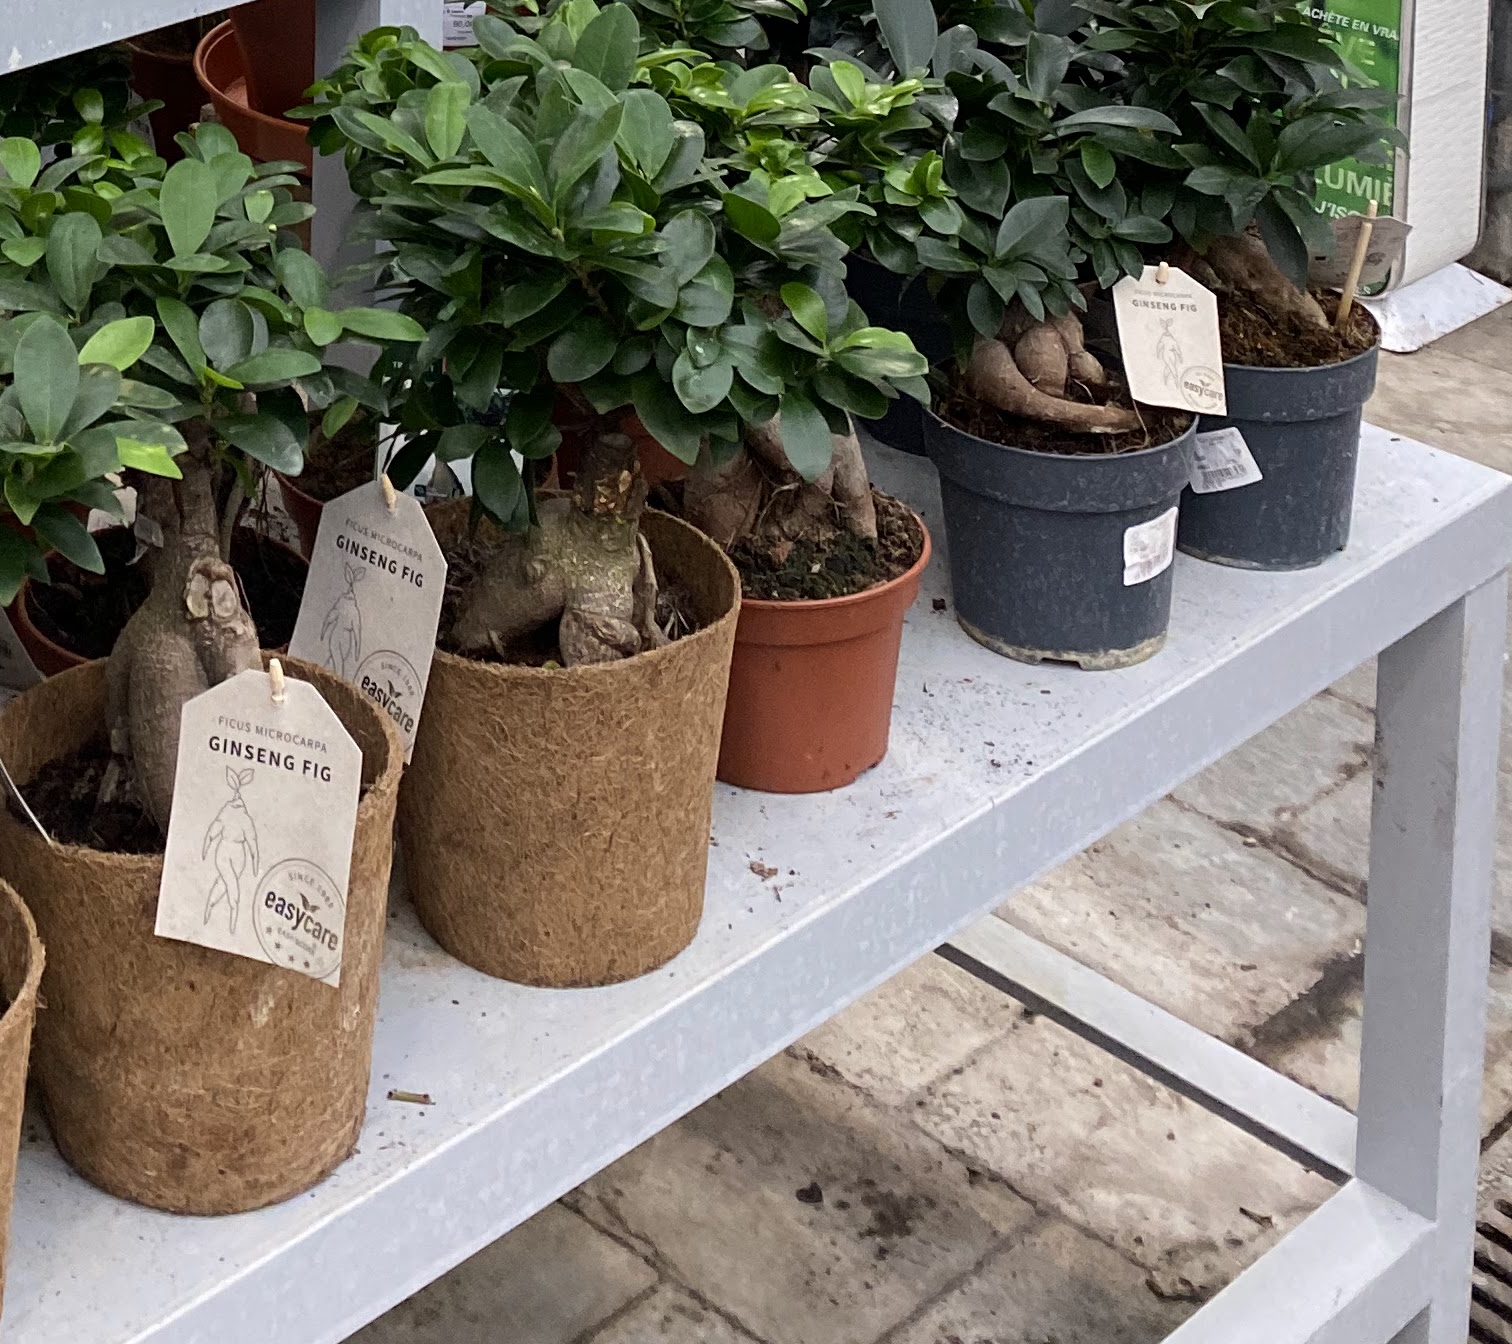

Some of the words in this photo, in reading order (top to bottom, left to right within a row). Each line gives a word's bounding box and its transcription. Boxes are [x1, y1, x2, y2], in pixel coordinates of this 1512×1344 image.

[1303, 6, 1351, 29] ACHÈTE
[1352, 20, 1370, 33] EN
[1373, 24, 1399, 41] VRA
[1132, 298, 1177, 311] GINSENG
[1179, 303, 1197, 313] FIG
[1184, 379, 1224, 402] easycare
[336, 533, 397, 575] GINSENG
[401, 566, 424, 589] FIG
[345, 518, 368, 538] FICUS
[370, 531, 423, 564] MICROCARPA
[218, 714, 252, 735] FICUS
[254, 723, 328, 754] MICROCARPA
[208, 735, 295, 771] GINSENG
[302, 761, 333, 783] FIG
[264, 890, 339, 951] easycare
